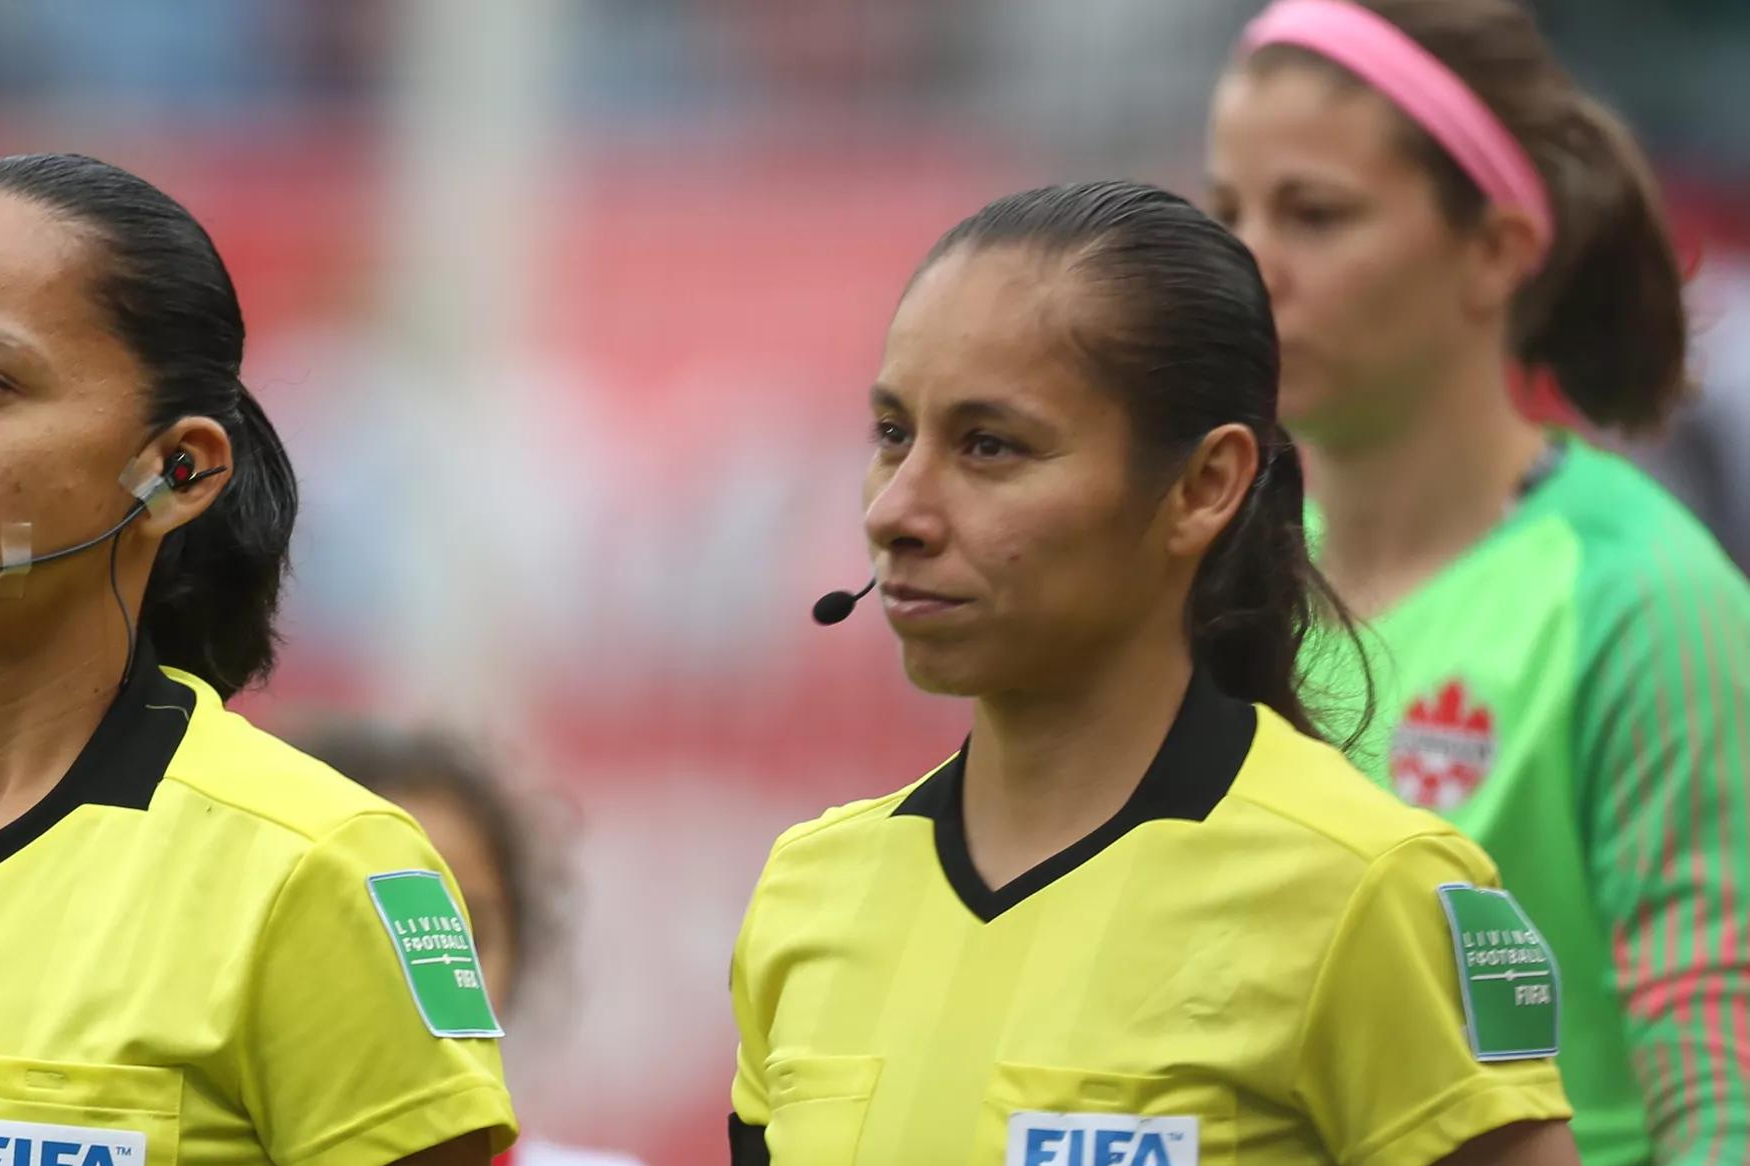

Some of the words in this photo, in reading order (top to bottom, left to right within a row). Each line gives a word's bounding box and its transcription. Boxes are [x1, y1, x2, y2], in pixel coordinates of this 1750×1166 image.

[394, 916, 462, 935] LIVING
[402, 935, 469, 952] FOOTBALL
[1463, 929, 1539, 948] LIVING
[1466, 948, 1547, 967] FOOTBALL
